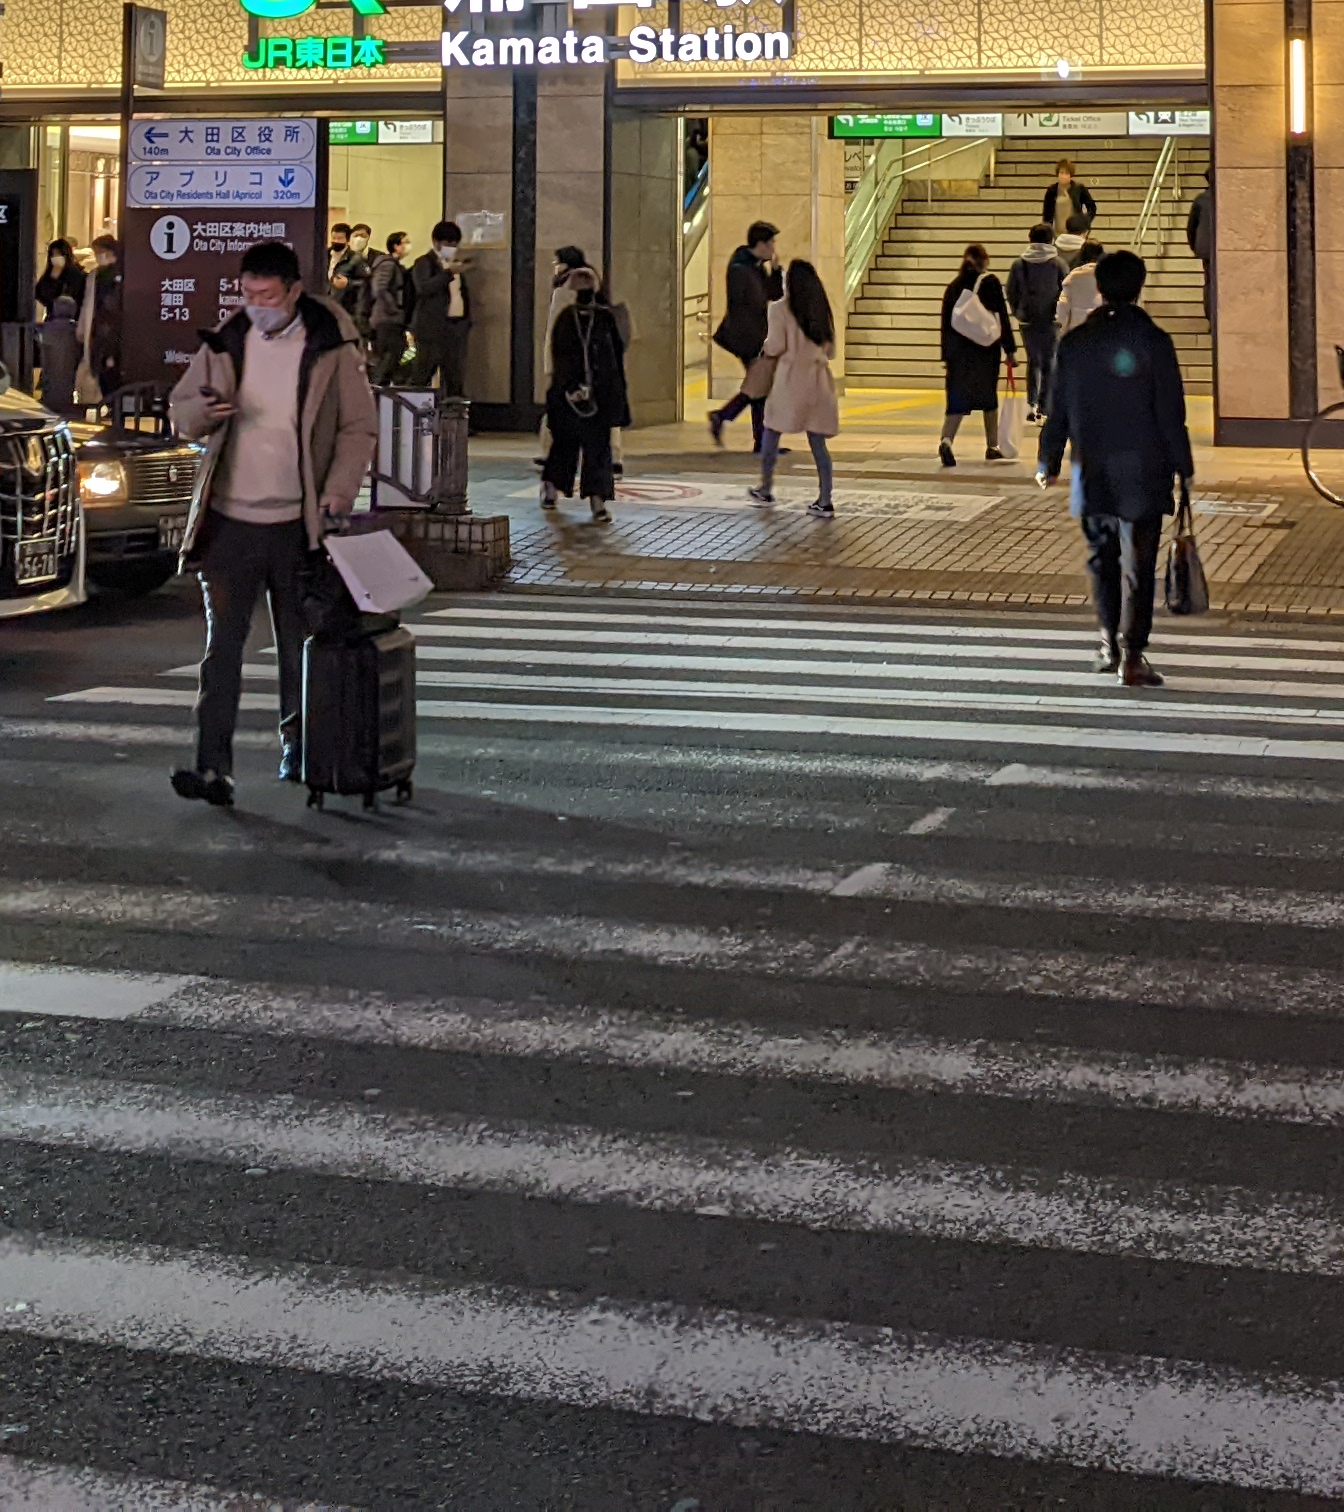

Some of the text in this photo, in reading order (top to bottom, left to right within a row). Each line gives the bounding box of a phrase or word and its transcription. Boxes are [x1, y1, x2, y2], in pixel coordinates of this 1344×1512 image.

[441, 24, 789, 66] Kamata Station
[242, 35, 385, 69] JR東日本
[179, 126, 300, 144] 大田区役所
[143, 146, 169, 156] 140m
[206, 146, 272, 157] Ota City Office
[145, 170, 263, 187] アプリコ
[144, 190, 157, 199] Ota
[159, 190, 174, 201] City
[176, 190, 213, 199] Residents
[216, 190, 230, 199] Hall
[273, 191, 300, 199] 320m
[193, 222, 285, 237] 大田区案内地図
[193, 239, 207, 251] Ota
[209, 239, 225, 254] City
[161, 279, 195, 291] 大田区
[161, 308, 190, 320] 5-13
